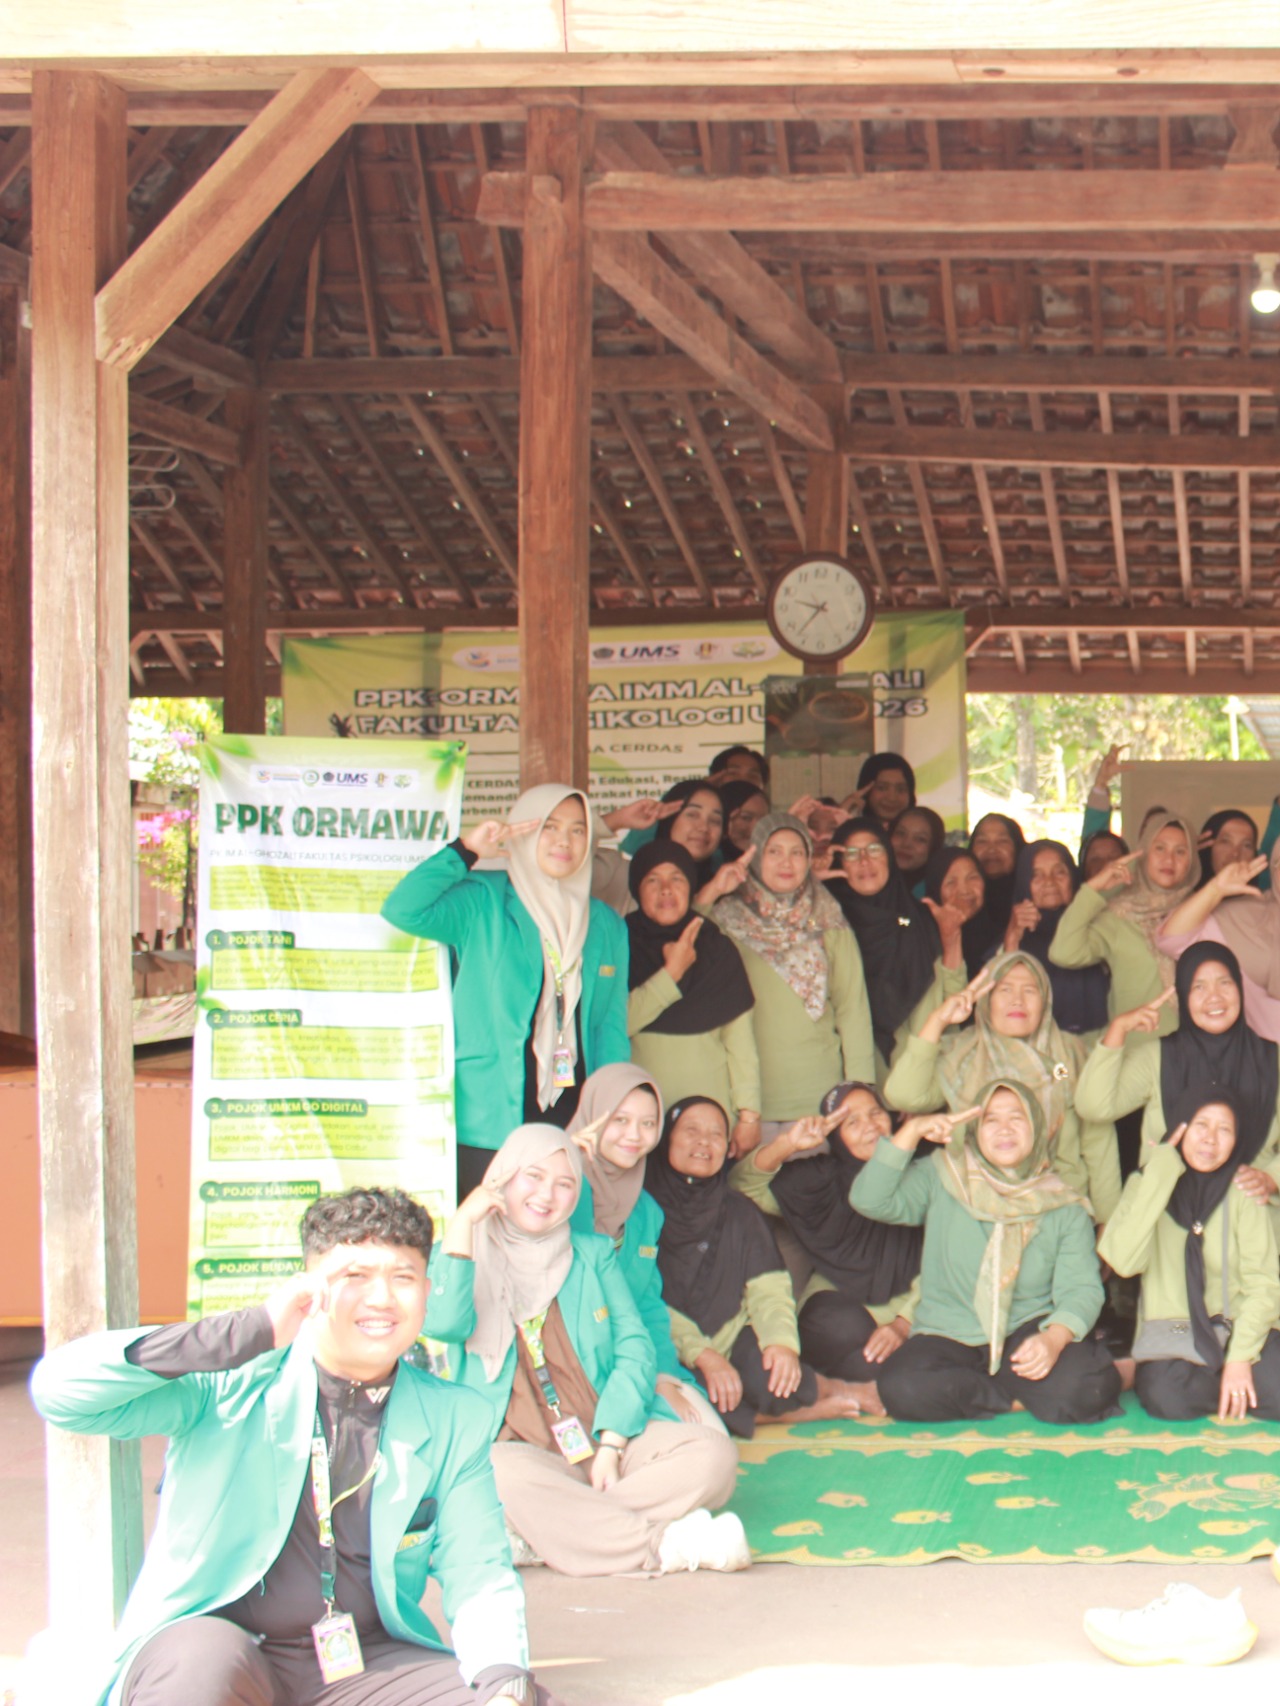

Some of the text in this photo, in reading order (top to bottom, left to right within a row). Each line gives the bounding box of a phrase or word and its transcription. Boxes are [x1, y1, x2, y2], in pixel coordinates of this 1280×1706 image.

[619, 644, 680, 659] UMS
[355, 688, 433, 708] PPK
[620, 679, 697, 700] IMM
[356, 713, 520, 735] FAKULTA
[610, 743, 683, 754] CERDAS
[336, 772, 369, 785] UMS
[214, 802, 450, 842] PPK ORMAWA
[228, 935, 264, 947] POJOK
[213, 1014, 224, 1024] 2.
[228, 1013, 267, 1025] POJOK
[211, 1104, 222, 1113] 3.
[226, 1102, 267, 1114] POJOK
[321, 1102, 365, 1114] DIGITAL
[207, 1184, 318, 1198] 4. POJOK HARMONI
[202, 1263, 215, 1274] 5.
[218, 1262, 260, 1274] POJOK
